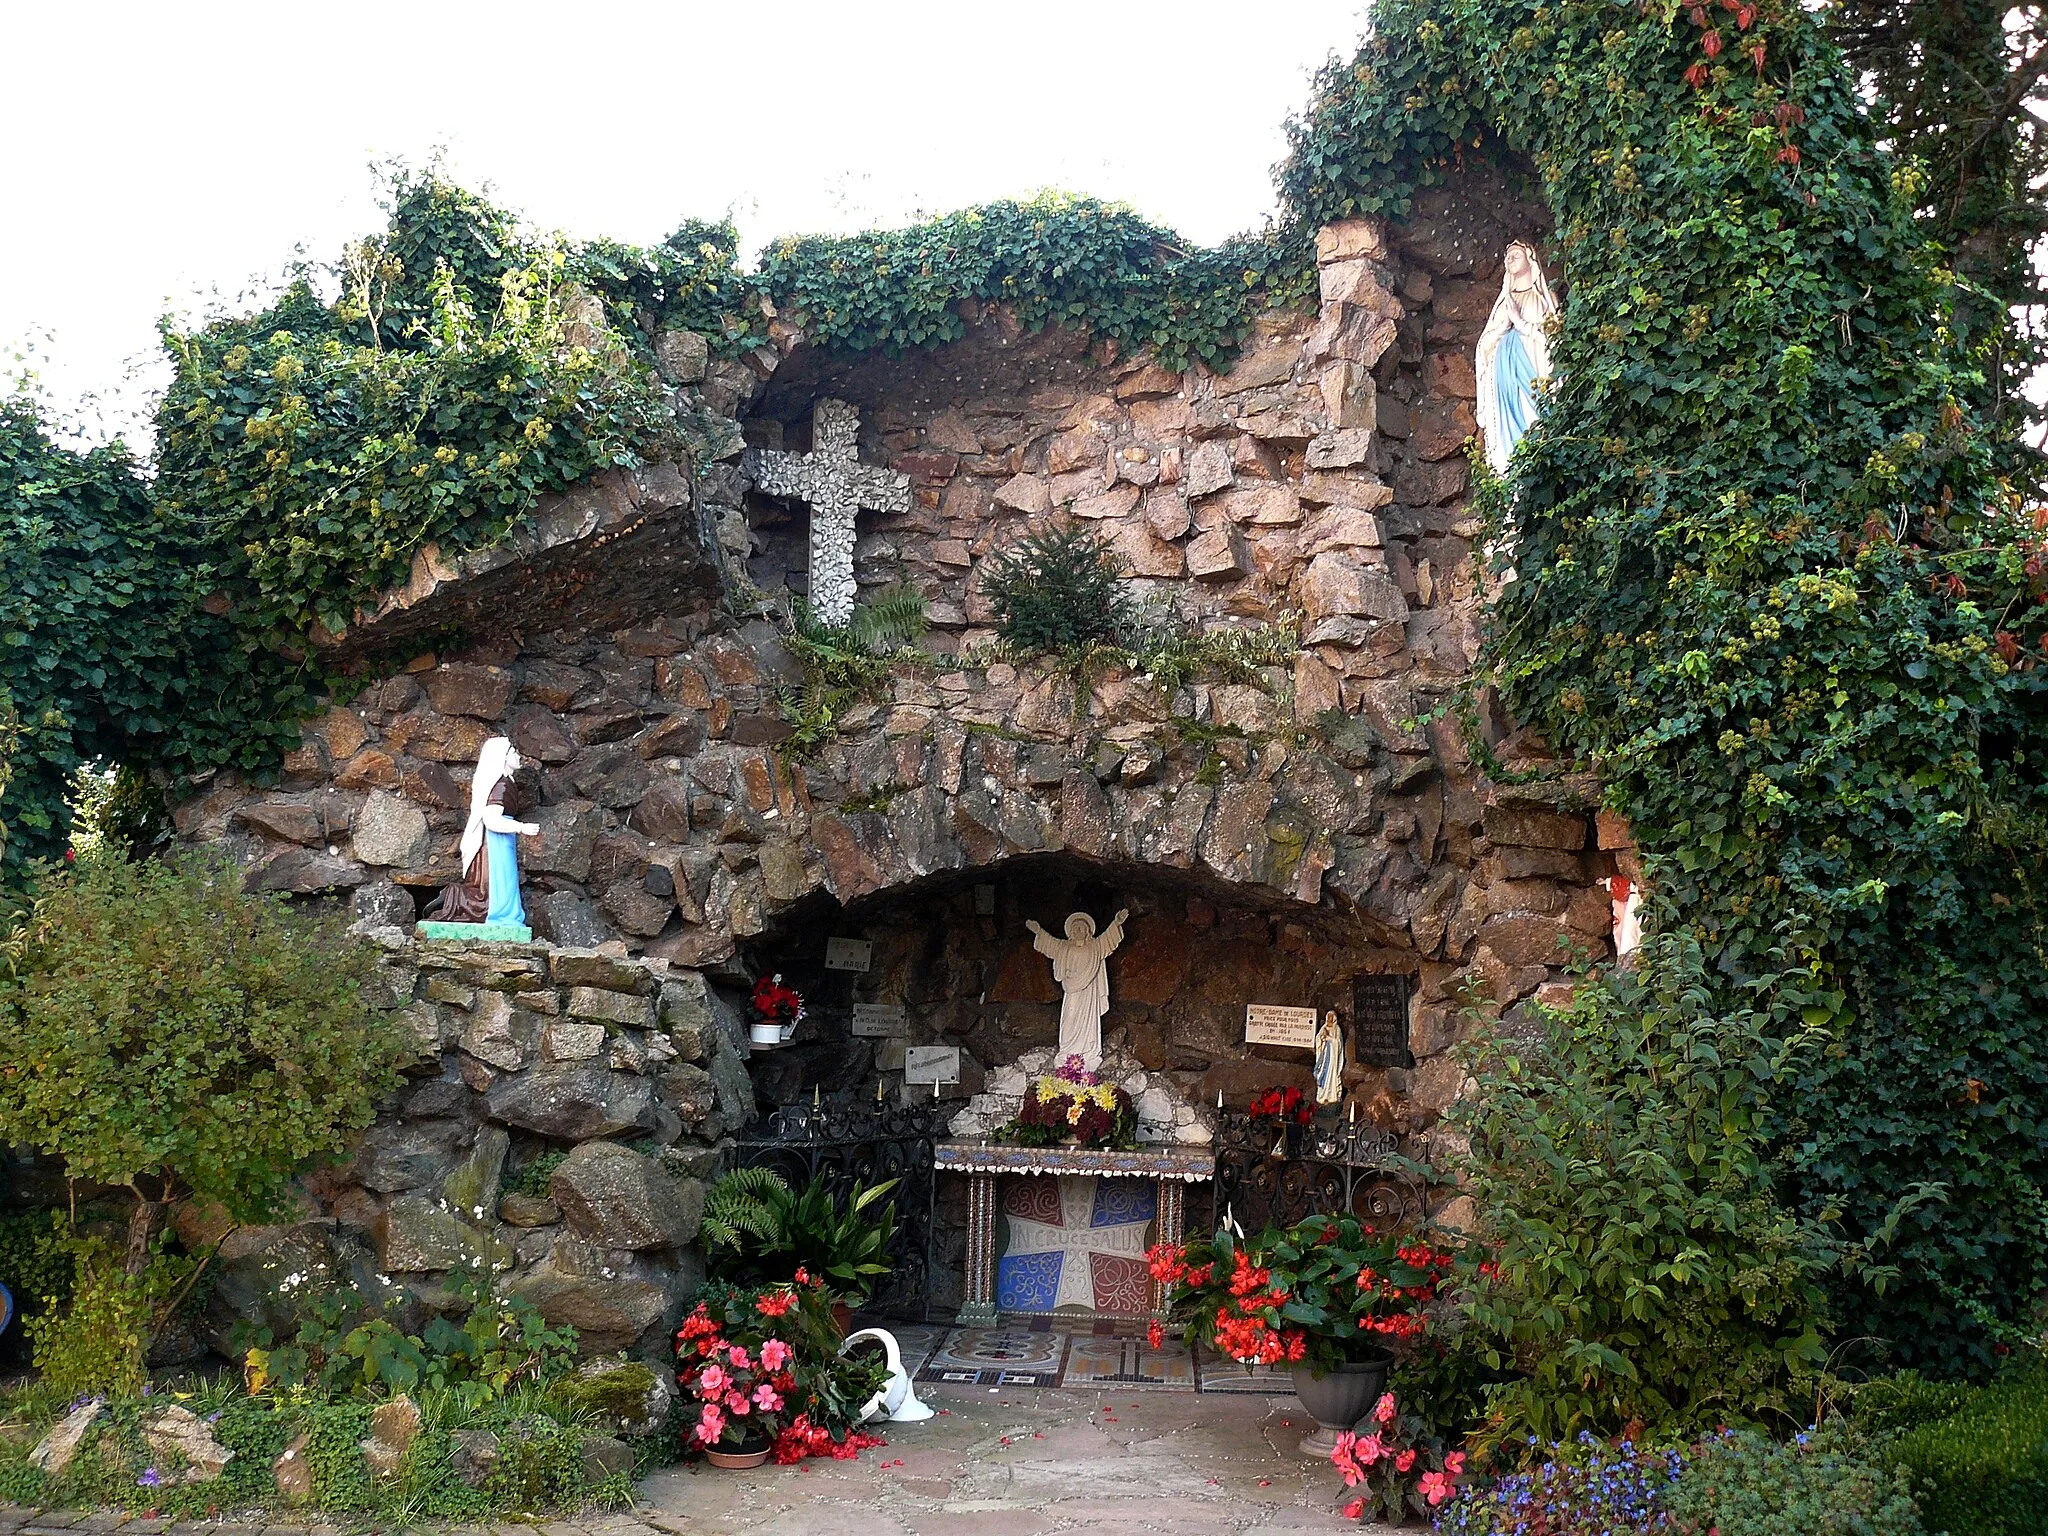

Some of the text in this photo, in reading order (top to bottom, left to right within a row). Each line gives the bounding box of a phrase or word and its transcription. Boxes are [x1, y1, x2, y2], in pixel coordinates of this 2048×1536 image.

[1013, 1223, 1142, 1253] IN CRUCE SALUS
